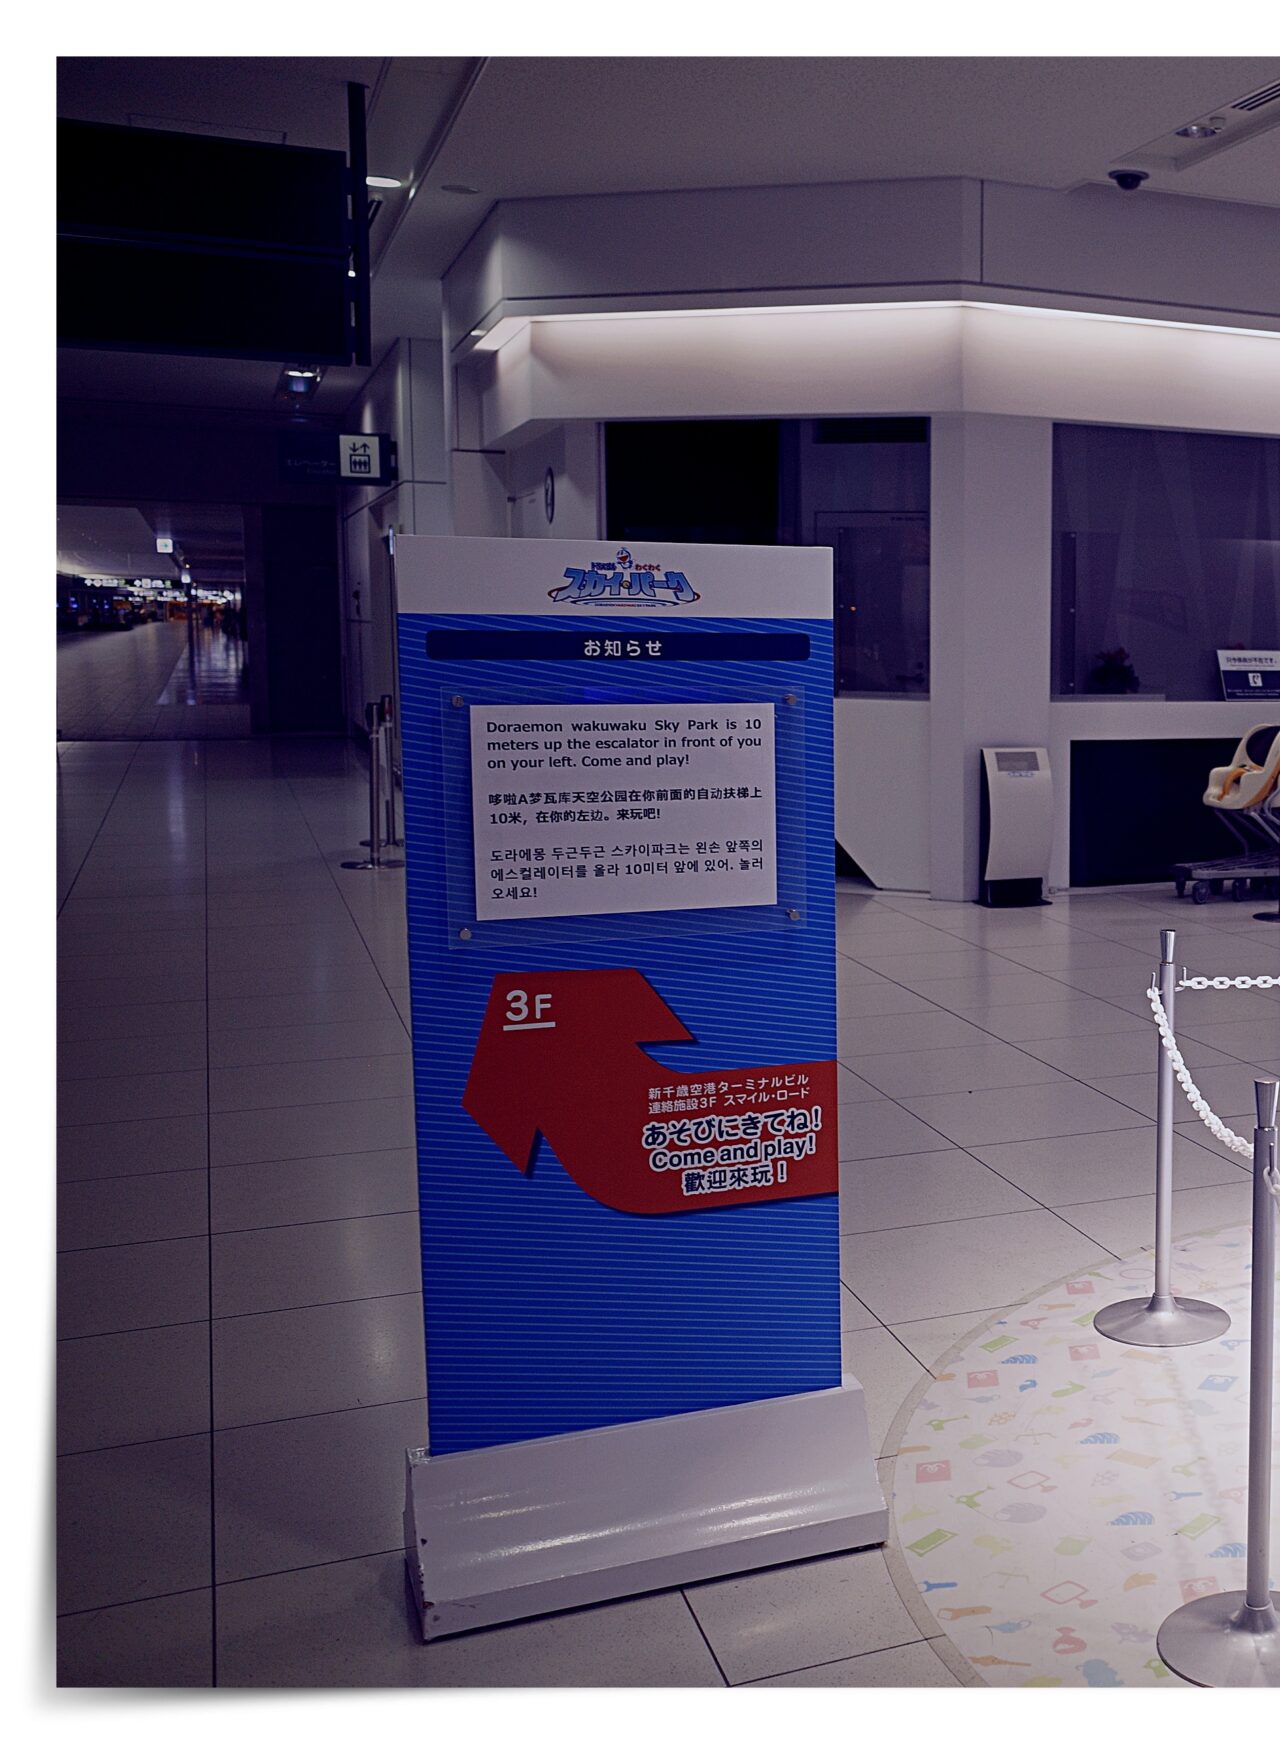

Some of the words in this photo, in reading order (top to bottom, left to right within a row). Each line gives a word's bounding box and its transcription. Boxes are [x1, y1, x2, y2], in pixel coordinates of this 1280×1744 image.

[584, 639, 662, 657] お知らせ
[486, 721, 563, 733] Doraemon
[571, 720, 647, 732] wakuwaku
[654, 719, 680, 733] Sky
[688, 719, 718, 731] Park
[726, 718, 737, 730] is
[745, 718, 761, 730] 10
[487, 739, 539, 751] meters
[544, 740, 562, 752] up
[567, 738, 591, 750] the
[595, 737, 659, 749] escalator
[664, 737, 677, 748] in
[681, 736, 715, 748] front
[720, 736, 733, 747] of
[737, 737, 761, 749] you
[487, 759, 506, 769] on
[511, 759, 544, 771] your
[549, 756, 577, 768] left.
[581, 755, 622, 767] Come
[626, 754, 652, 766] and
[656, 754, 689, 768] play!
[488, 786, 763, 806] 哆啦A梦瓦库天空公园在你前面的自动扶梯上
[490, 848, 546, 862] 도라에몽
[551, 846, 606, 861] 두근두근
[611, 843, 690, 858] 스카이파크는
[695, 841, 721, 855] 왼손
[725, 839, 763, 854] 앞쪽의
[490, 864, 588, 882] 에스컬레이터를
[593, 863, 620, 878] 올라
[625, 861, 668, 875] 10미터
[673, 860, 699, 874] 앞에
[704, 859, 734, 873] 있어.
[739, 857, 763, 872] 놀러
[491, 886, 537, 900] 오세요!
[505, 989, 553, 1022] 3F
[648, 1074, 809, 1100] 新千歳空港ターミナルビル
[648, 1097, 717, 1115] 連絡施設3F
[723, 1087, 811, 1107] スマイル・ロード
[651, 1149, 715, 1169] Come
[720, 1141, 762, 1160] and
[764, 1135, 815, 1161] play!
